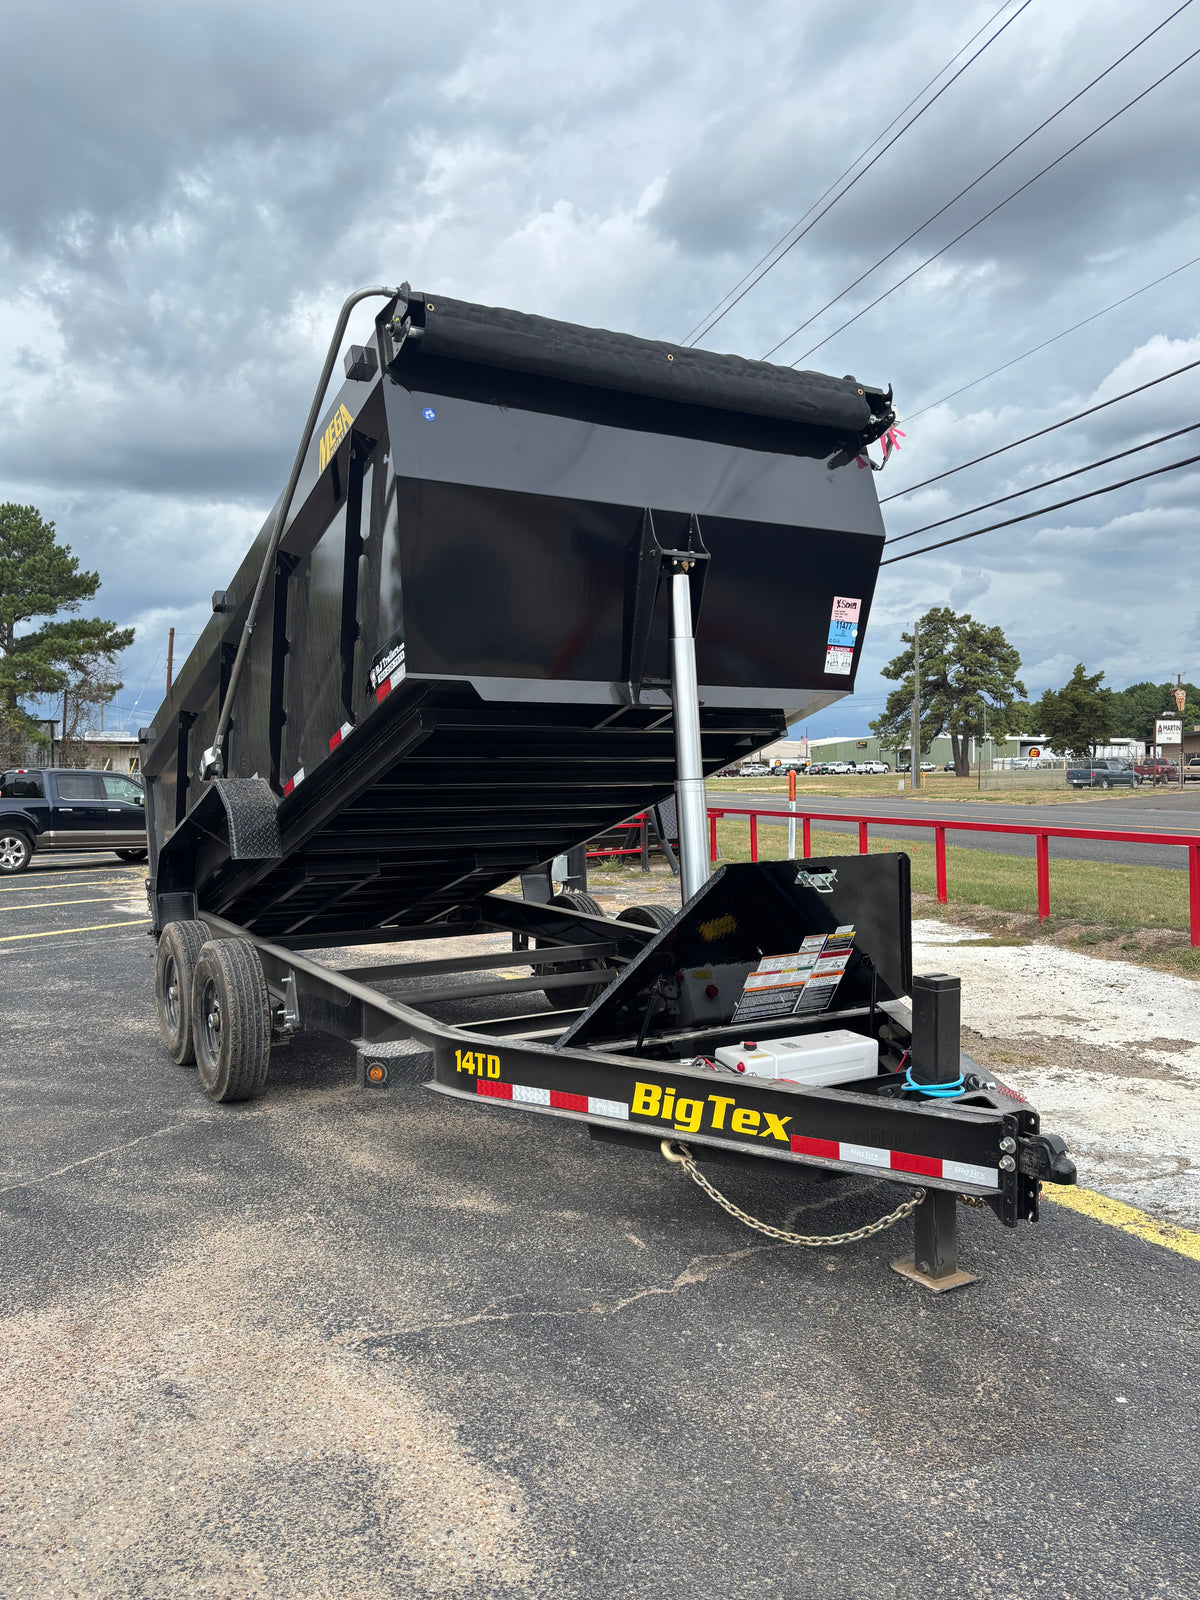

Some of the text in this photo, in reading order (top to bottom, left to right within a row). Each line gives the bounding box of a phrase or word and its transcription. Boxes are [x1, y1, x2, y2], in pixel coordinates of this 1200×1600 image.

[319, 403, 354, 477] MEGA
[455, 1049, 500, 1079] 14TD
[631, 1082, 793, 1142] BigTex
[954, 1166, 985, 1177] BigTex
